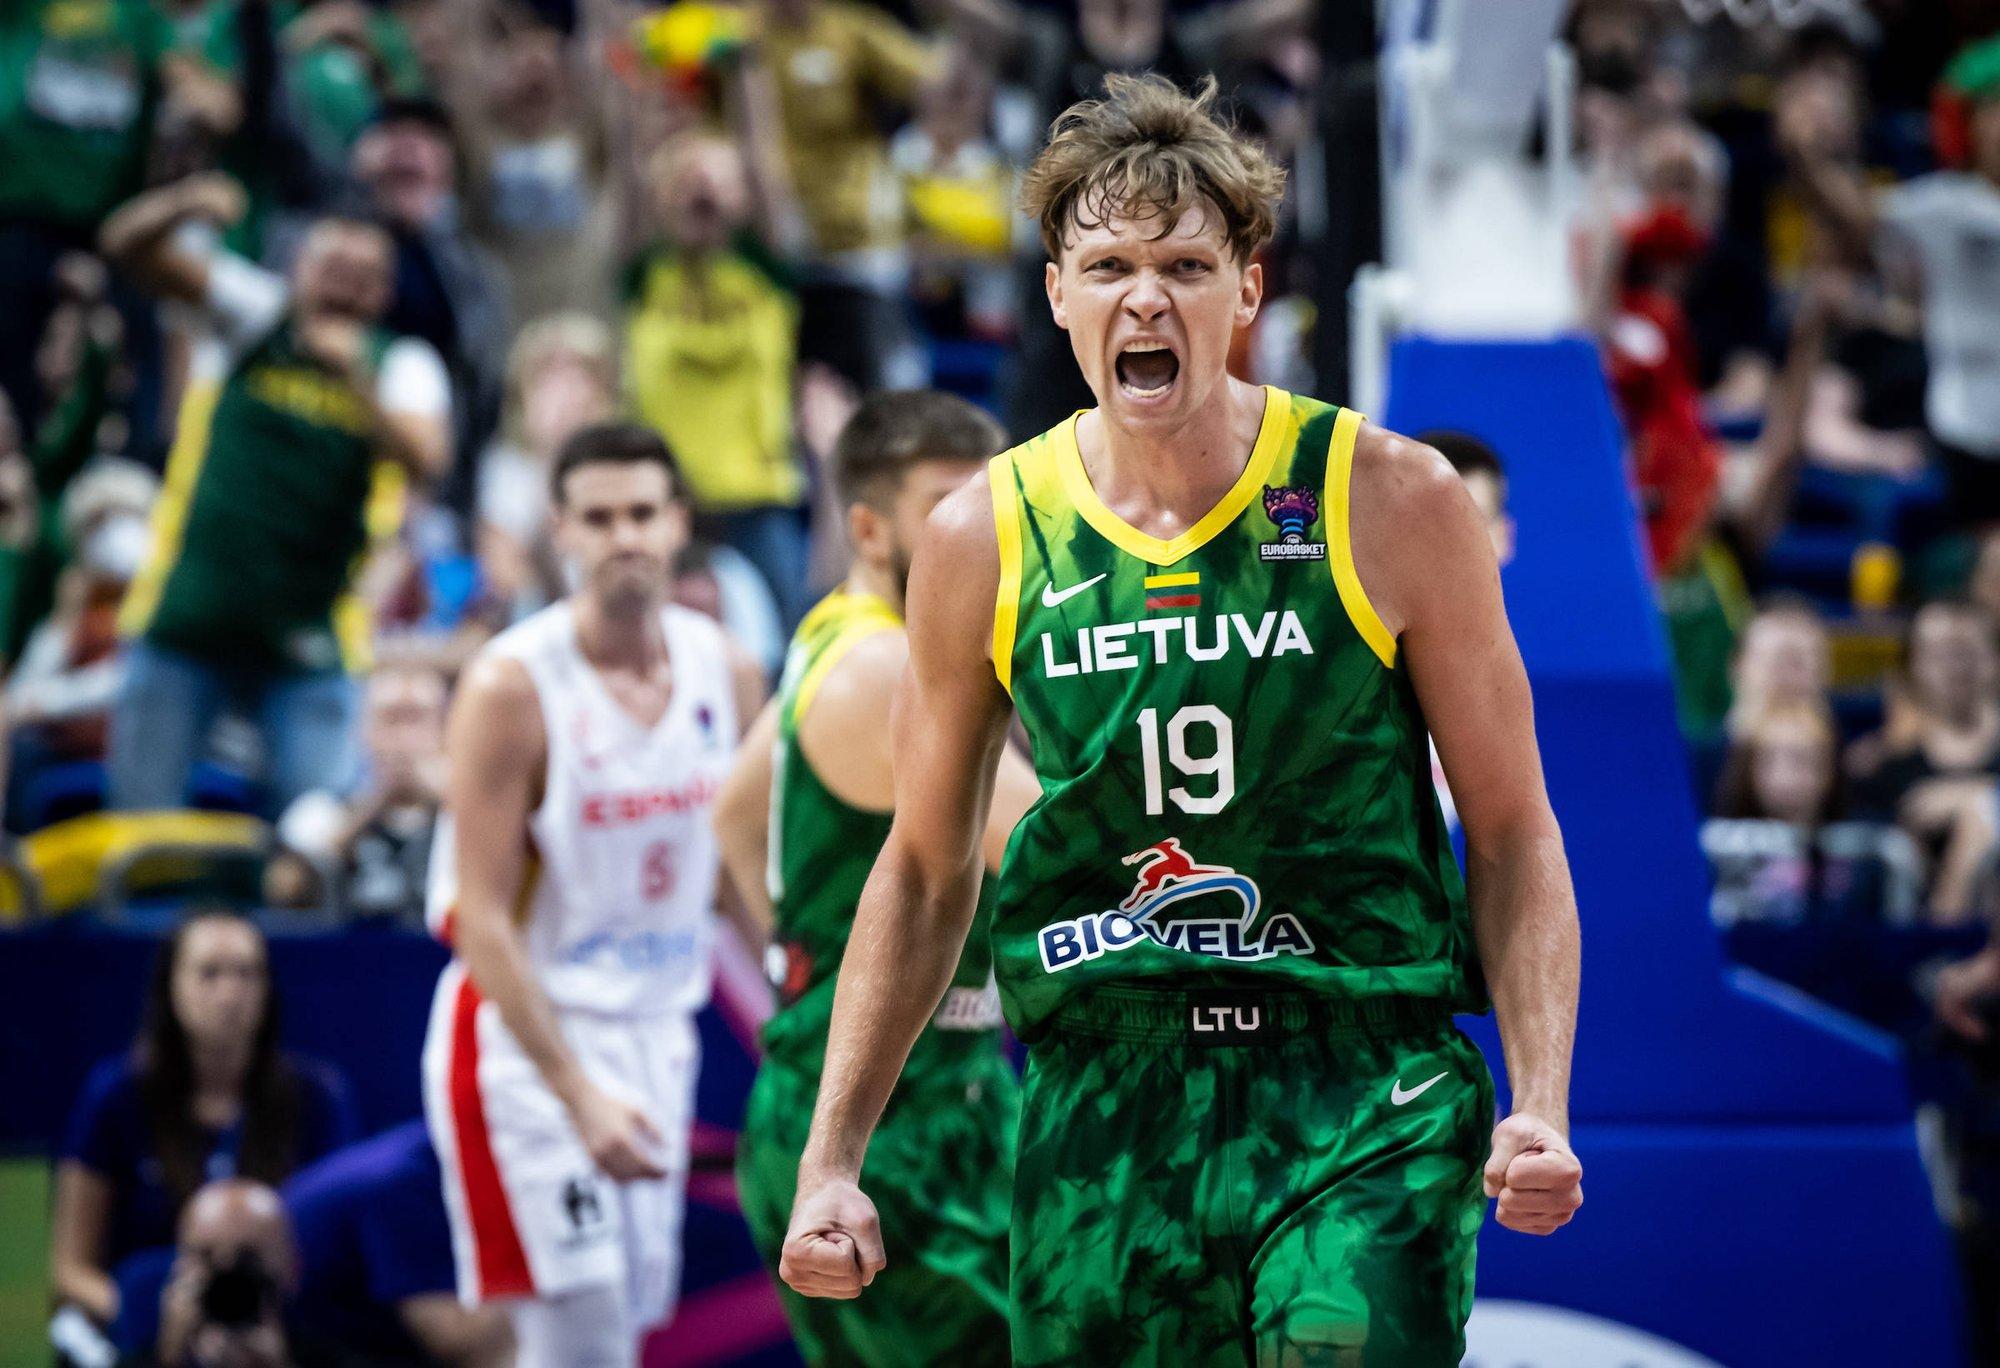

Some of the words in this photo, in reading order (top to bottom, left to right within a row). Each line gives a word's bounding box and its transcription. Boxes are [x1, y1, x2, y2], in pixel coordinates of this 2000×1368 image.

[1261, 544, 1325, 555] EUROBASKET
[1041, 610, 1314, 678] LIETUVA
[1136, 704, 1235, 815] 19
[1039, 911, 1314, 972] BIOVELA
[1193, 1006, 1260, 1031] LTU
